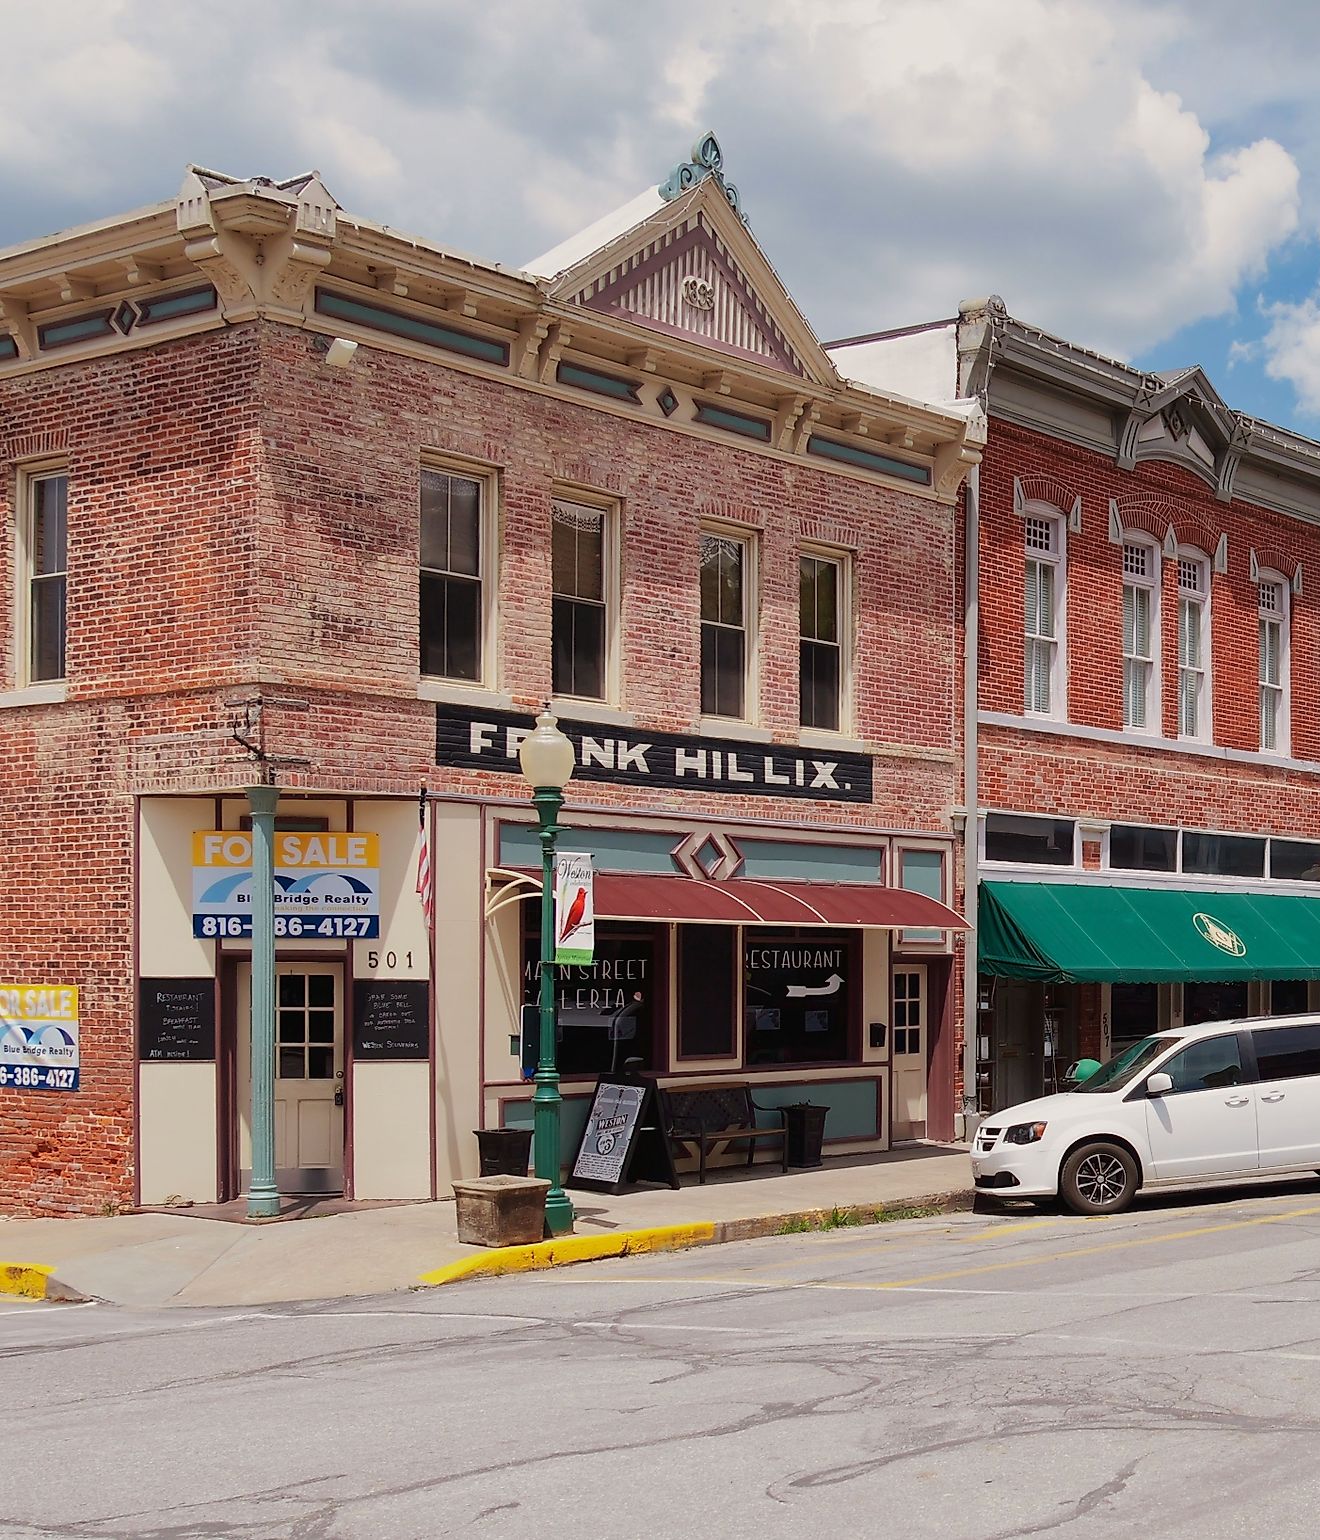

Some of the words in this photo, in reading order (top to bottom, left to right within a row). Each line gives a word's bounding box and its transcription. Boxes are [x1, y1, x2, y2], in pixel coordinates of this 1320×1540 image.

[470, 722, 650, 773] FRNK
[204, 836, 252, 864] FO
[282, 837, 368, 865] SALE
[558, 857, 592, 880] Weston
[275, 894, 319, 905] Bridge
[324, 894, 369, 905] Realty
[202, 916, 371, 937] 816-86-4127
[368, 951, 413, 969] 501
[524, 960, 571, 981] MAN
[579, 960, 648, 980] STREET
[0, 989, 21, 1018] OR
[26, 989, 72, 1018] SALE
[524, 988, 625, 1010] LERIA
[3, 1045, 21, 1053] Blue
[22, 1046, 47, 1057] Bridge
[49, 1047, 74, 1058] Realty
[0, 1066, 75, 1088] 6-386-4127
